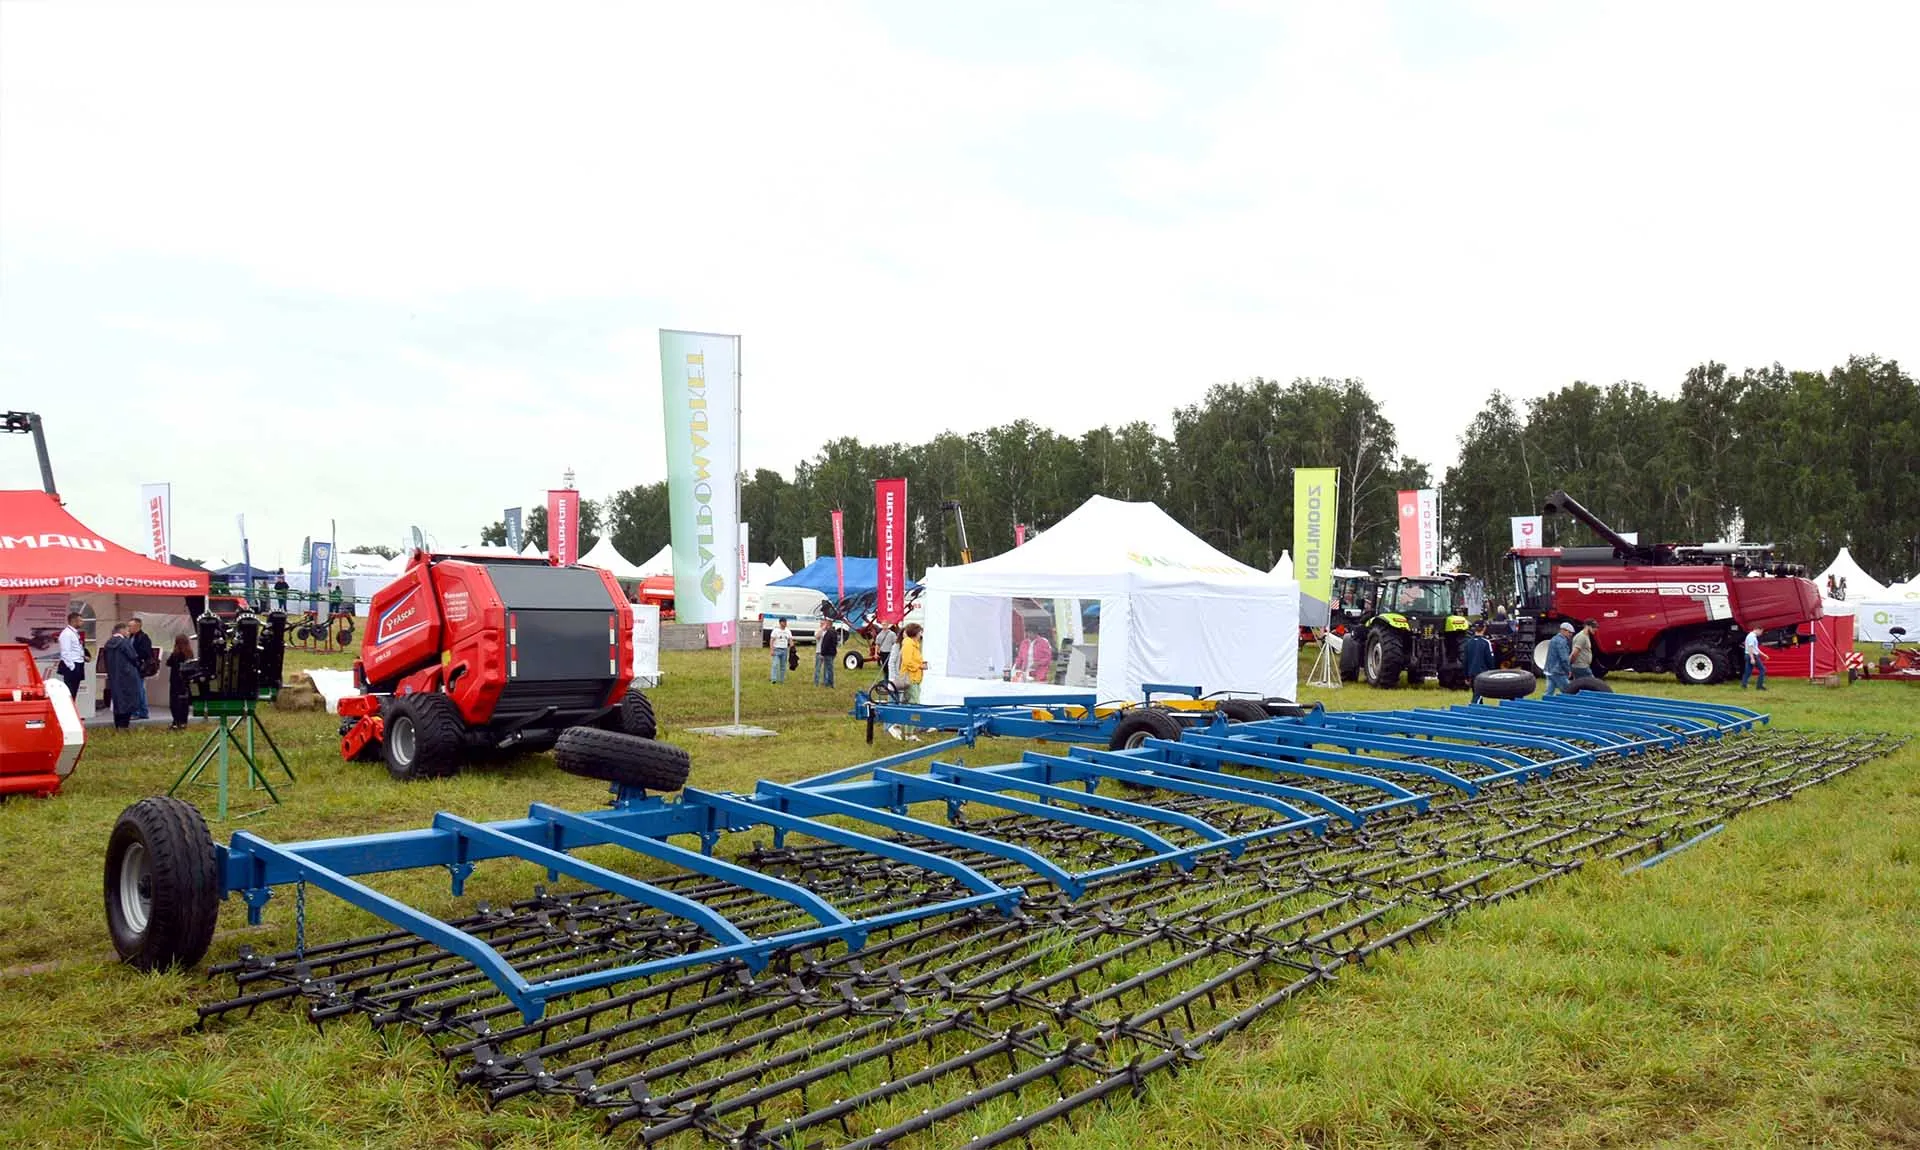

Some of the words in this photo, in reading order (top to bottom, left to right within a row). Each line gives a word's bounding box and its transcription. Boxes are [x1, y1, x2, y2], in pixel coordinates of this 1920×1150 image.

[0, 533, 106, 552] МАШ
[64, 574, 197, 589] профессионалов
[1686, 584, 1720, 594] GS12
